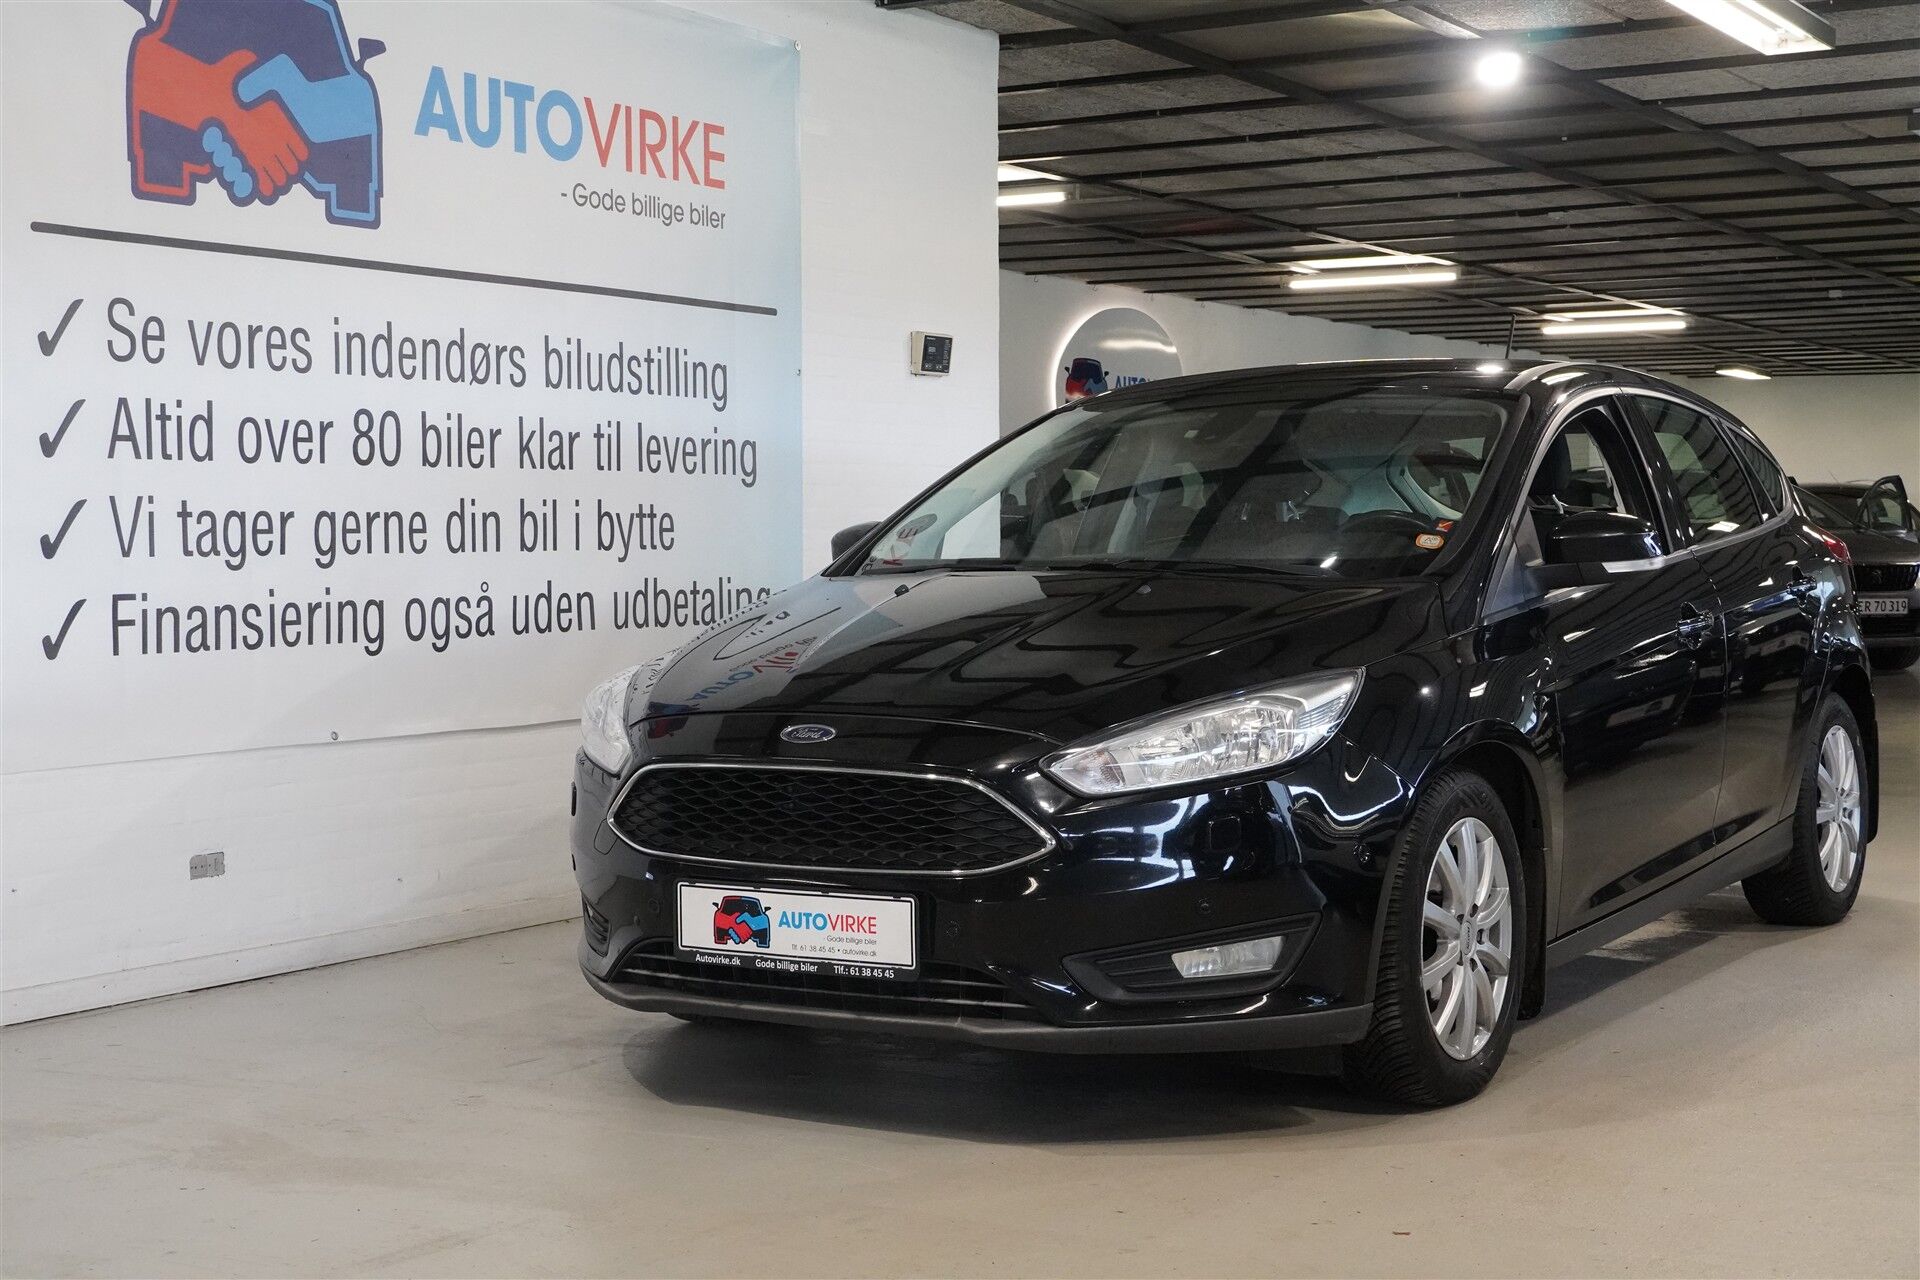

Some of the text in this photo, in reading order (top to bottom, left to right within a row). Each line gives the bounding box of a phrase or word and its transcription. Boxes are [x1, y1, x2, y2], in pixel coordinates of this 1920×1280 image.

[414, 65, 725, 189] AUTOVIRKE
[572, 183, 626, 213] Gode
[631, 192, 684, 227] billige
[690, 203, 726, 229] biler
[107, 298, 728, 412] Se vores indendørs biludstilling
[107, 398, 757, 488] Altid over 80 biler klar til levering
[108, 495, 675, 572] Vi tager gerne din bil i bytte
[111, 586, 385, 657] Finansiering
[404, 581, 496, 653] også
[512, 579, 596, 636] uden
[1874, 600, 1887, 612] 70
[1889, 600, 1907, 612] 319
[778, 911, 877, 935] AUTOVIRKE
[826, 934, 877, 946] Gode billige biler
[695, 953, 741, 966] Autovirke.dk
[755, 959, 775, 969] Gode
[776, 960, 799, 972] billige
[800, 961, 818, 972] biler
[850, 967, 860, 977] 61
[861, 968, 871, 978] 38
[872, 968, 883, 978] 45
[884, 969, 895, 979] 45
